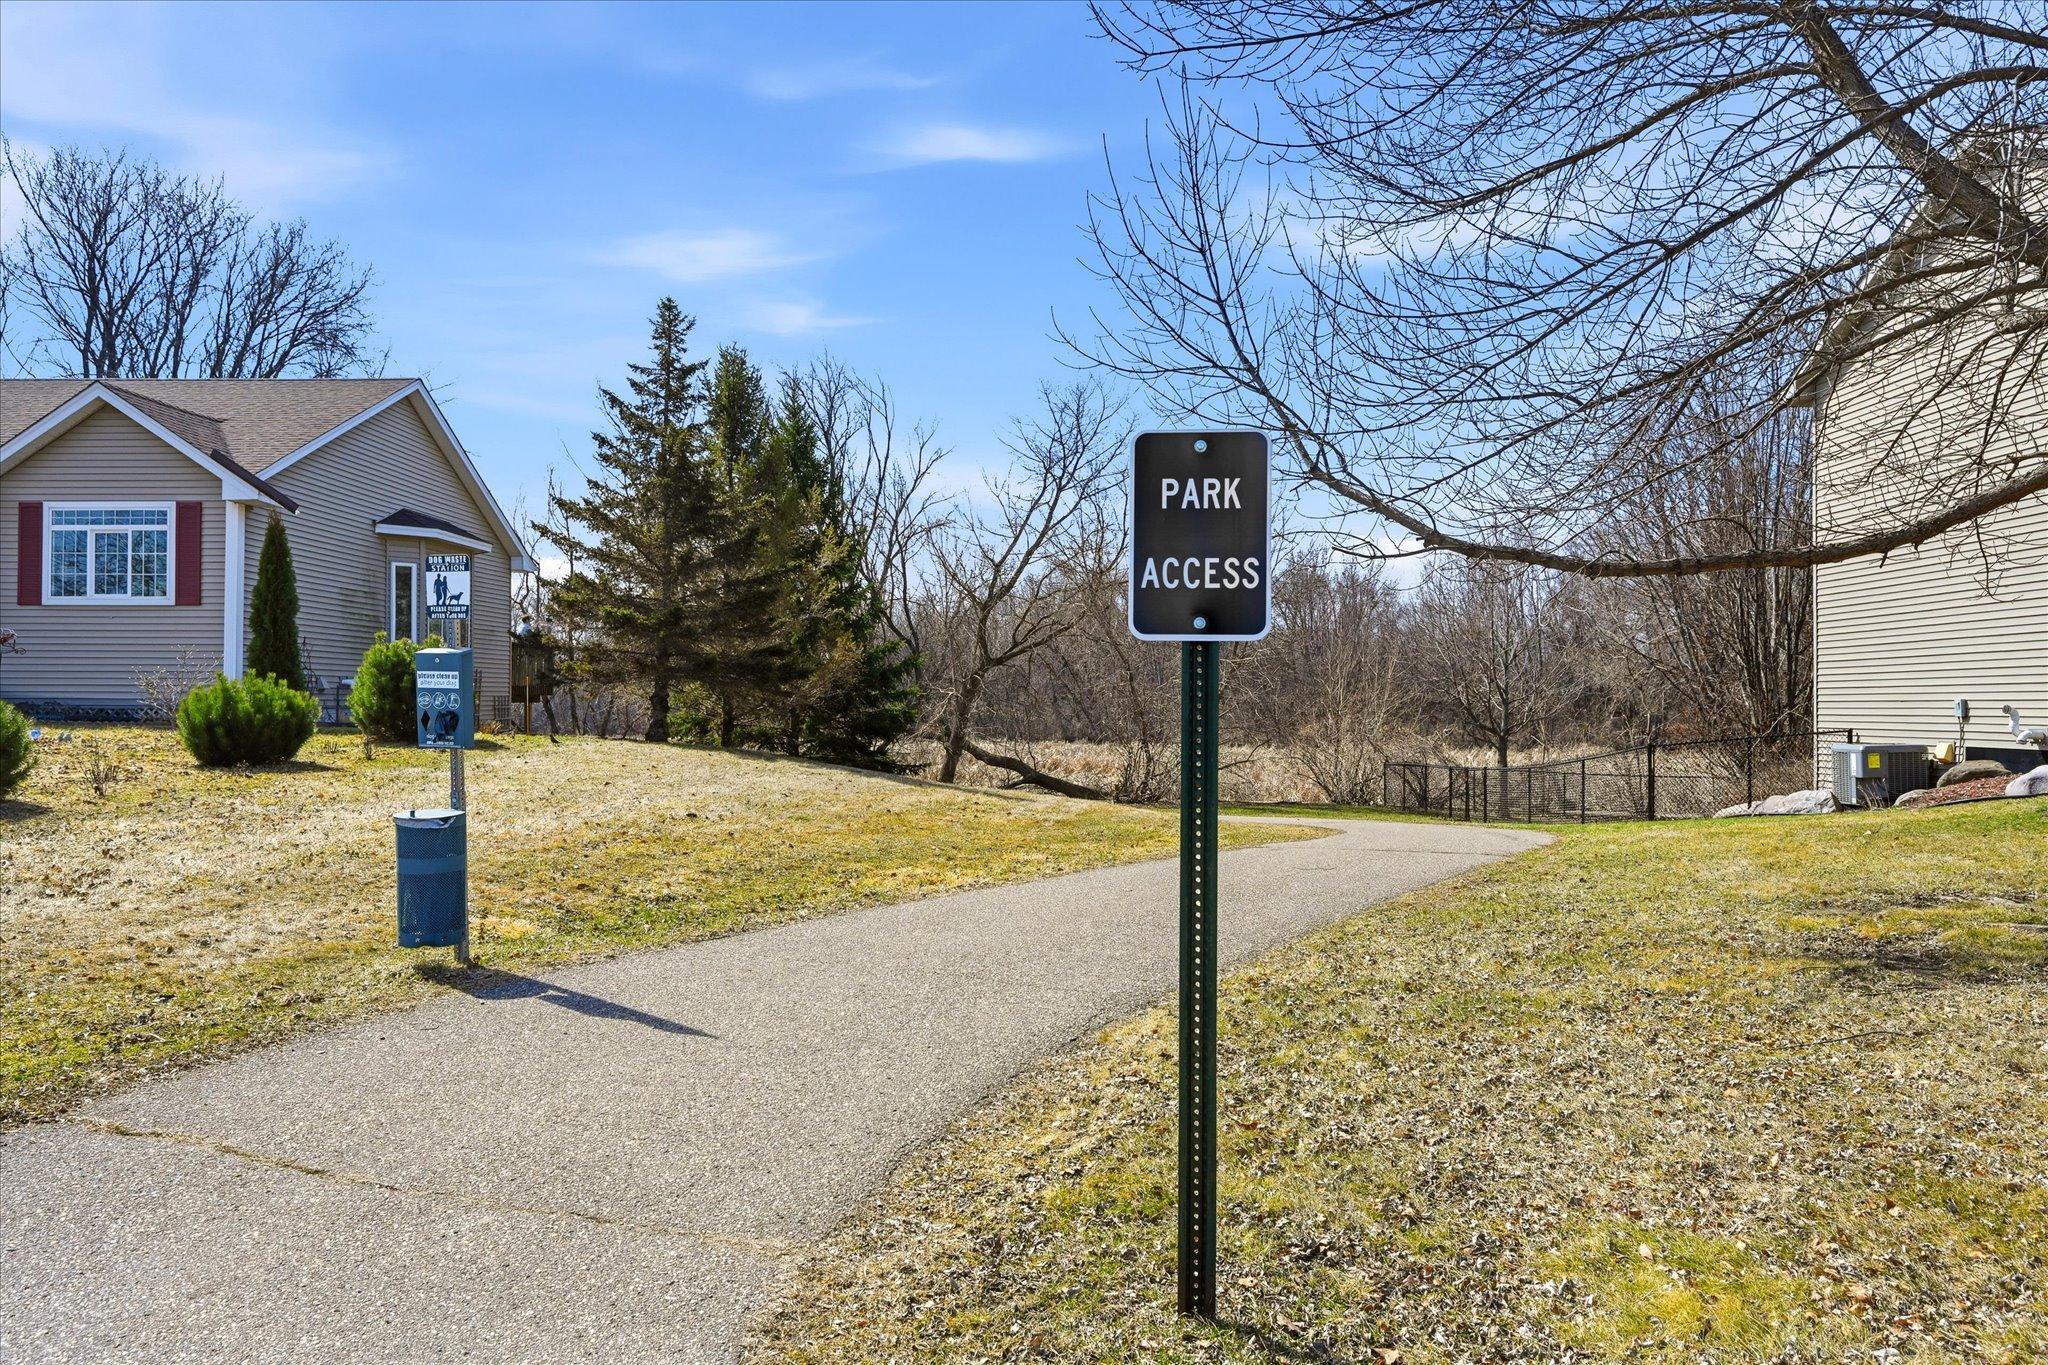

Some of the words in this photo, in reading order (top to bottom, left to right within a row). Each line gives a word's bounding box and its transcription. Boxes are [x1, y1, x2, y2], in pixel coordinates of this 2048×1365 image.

[1161, 477, 1241, 509] PARK
[428, 556, 442, 564] DOG
[445, 555, 467, 563] WASTE
[1140, 557, 1260, 589] ACCESS
